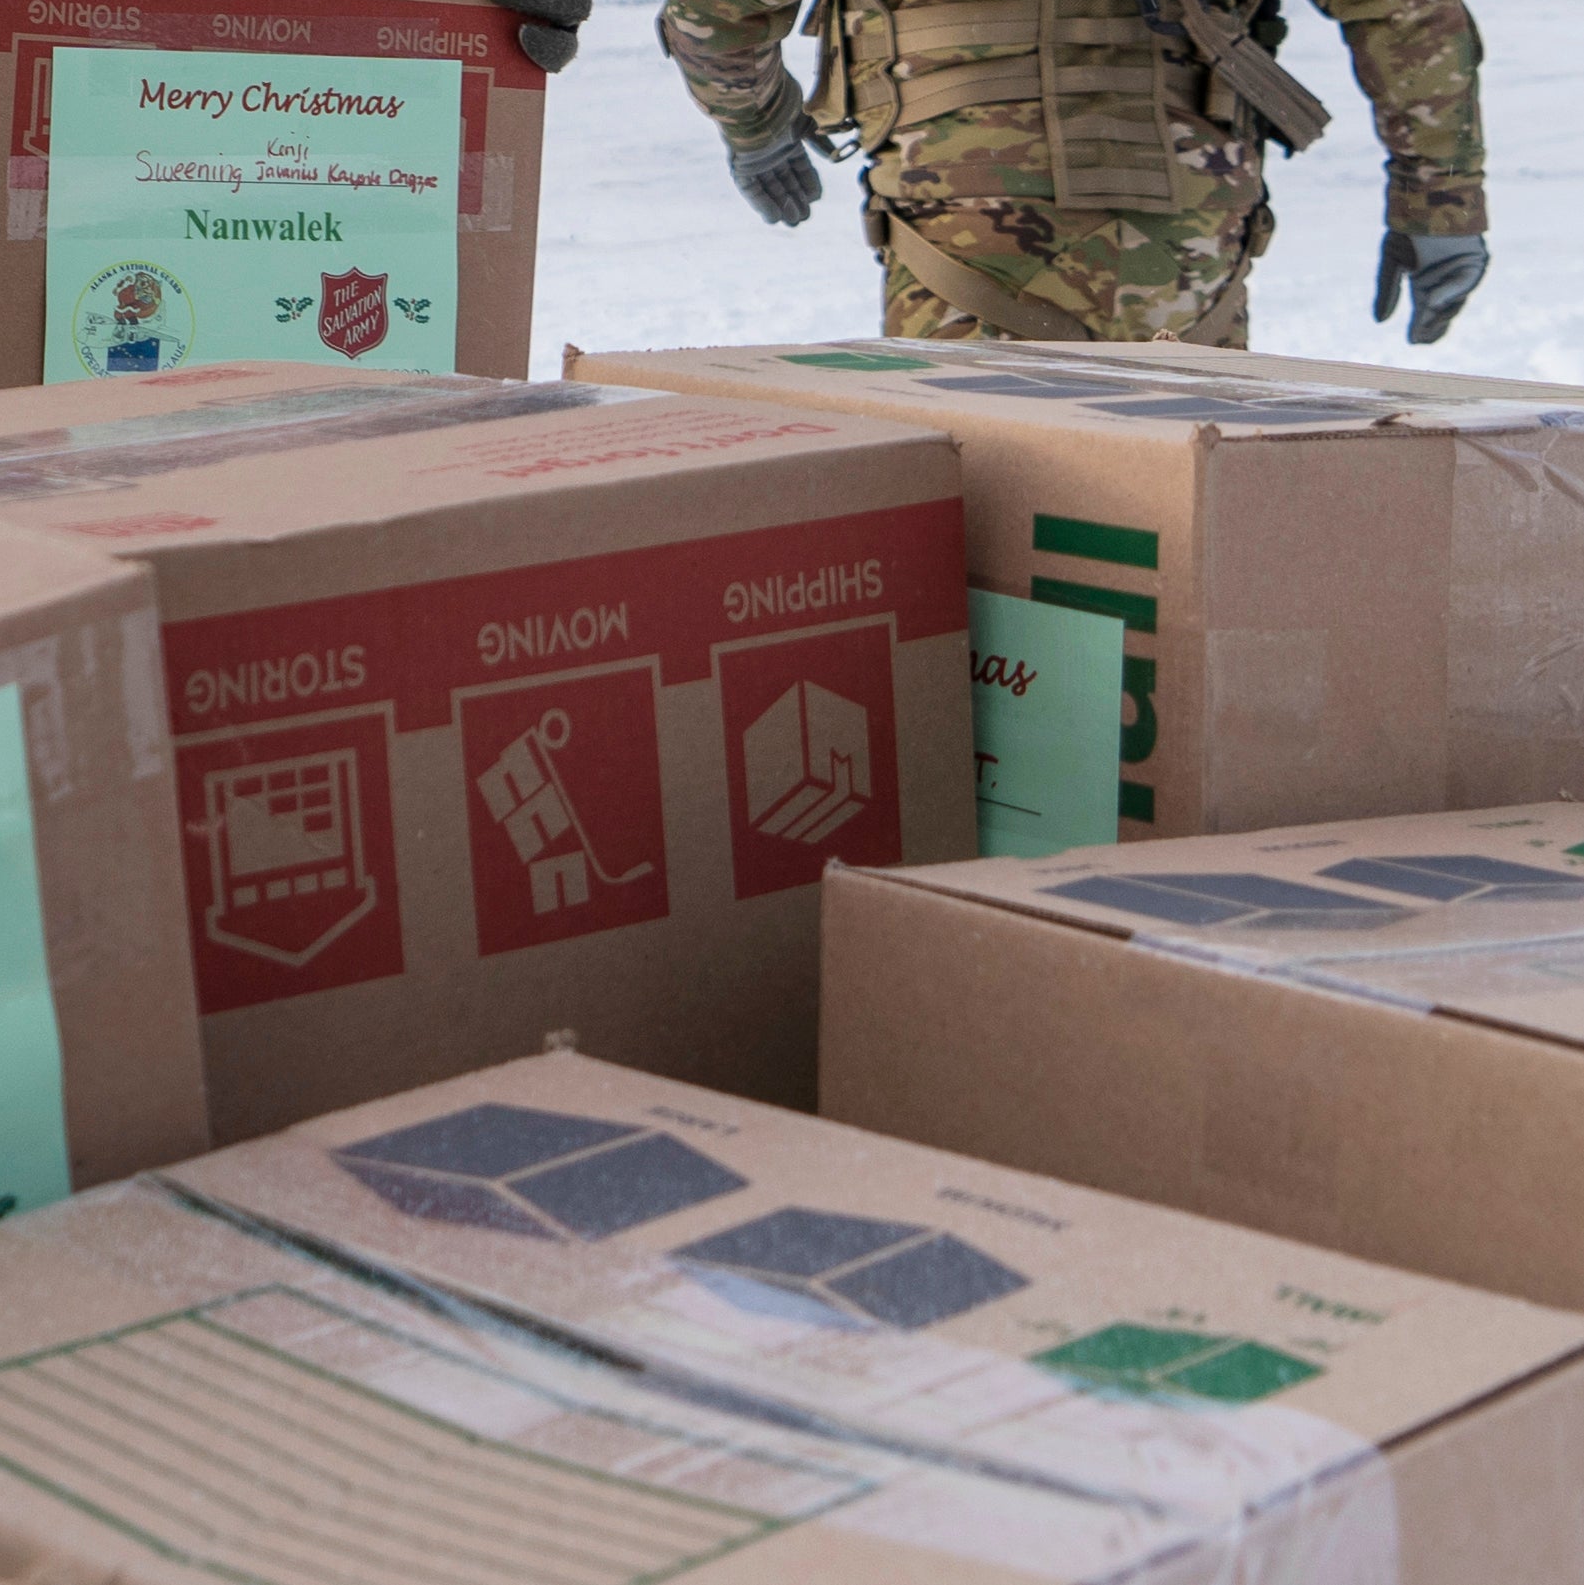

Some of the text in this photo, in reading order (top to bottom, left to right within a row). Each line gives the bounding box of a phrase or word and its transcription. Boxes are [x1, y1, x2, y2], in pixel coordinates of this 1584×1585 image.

[27, 0, 489, 58] SHIPPING MOVING STORING
[139, 79, 404, 119] Merry Christmas
[184, 209, 344, 243] Nanwalek
[323, 285, 382, 337] SALVATION
[333, 280, 359, 307] THE
[343, 309, 380, 349] ARMY
[185, 558, 884, 714] SHIPPING MOVING STORING
